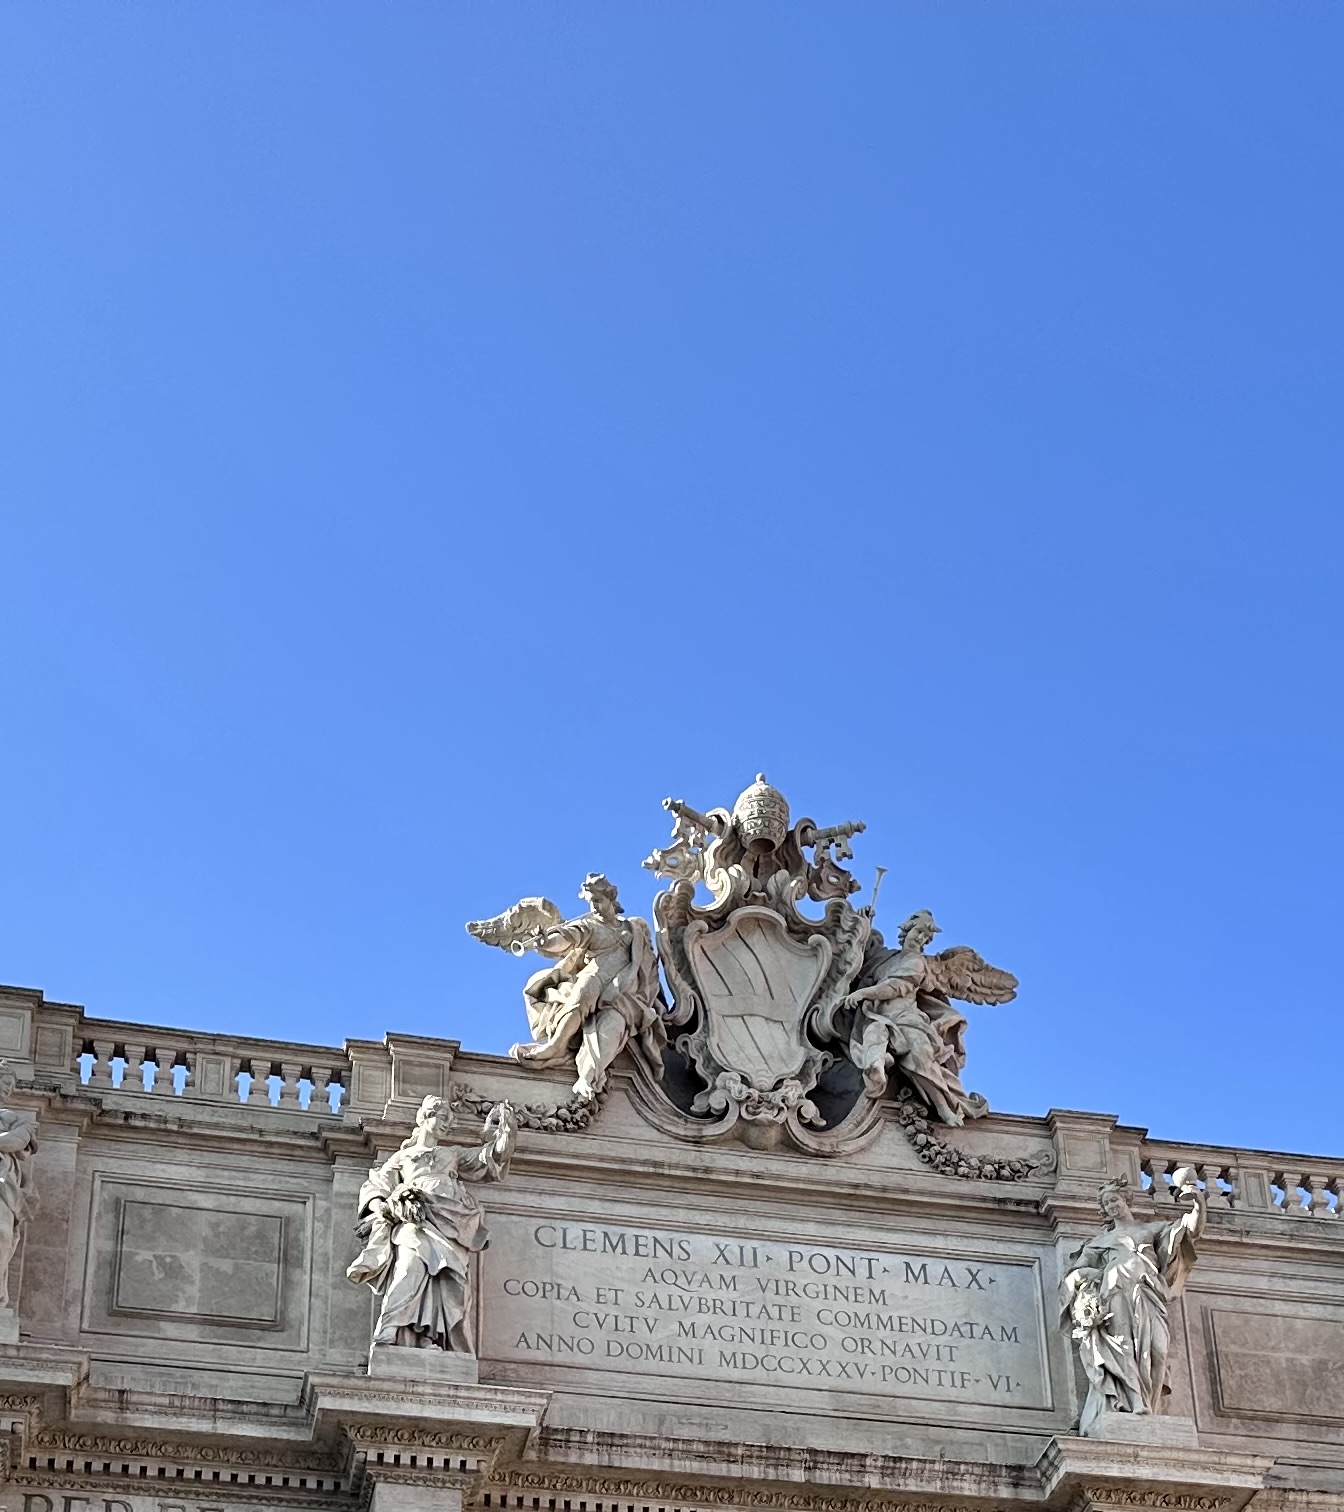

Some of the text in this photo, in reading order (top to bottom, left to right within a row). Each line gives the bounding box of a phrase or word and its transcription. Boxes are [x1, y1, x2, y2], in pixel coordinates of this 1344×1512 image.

[534, 1225, 692, 1262] CLEMENS
[641, 1266, 888, 1306] AQVAM VIRGINEM
[503, 1278, 1022, 1344] COPIA ET SALVBRITATE COMMENDATAM
[513, 1331, 595, 1356] ANNO
[605, 1339, 705, 1366] DOMINI
[572, 1311, 958, 1363] CVLTV MAGNIFICO ORNAVIT
